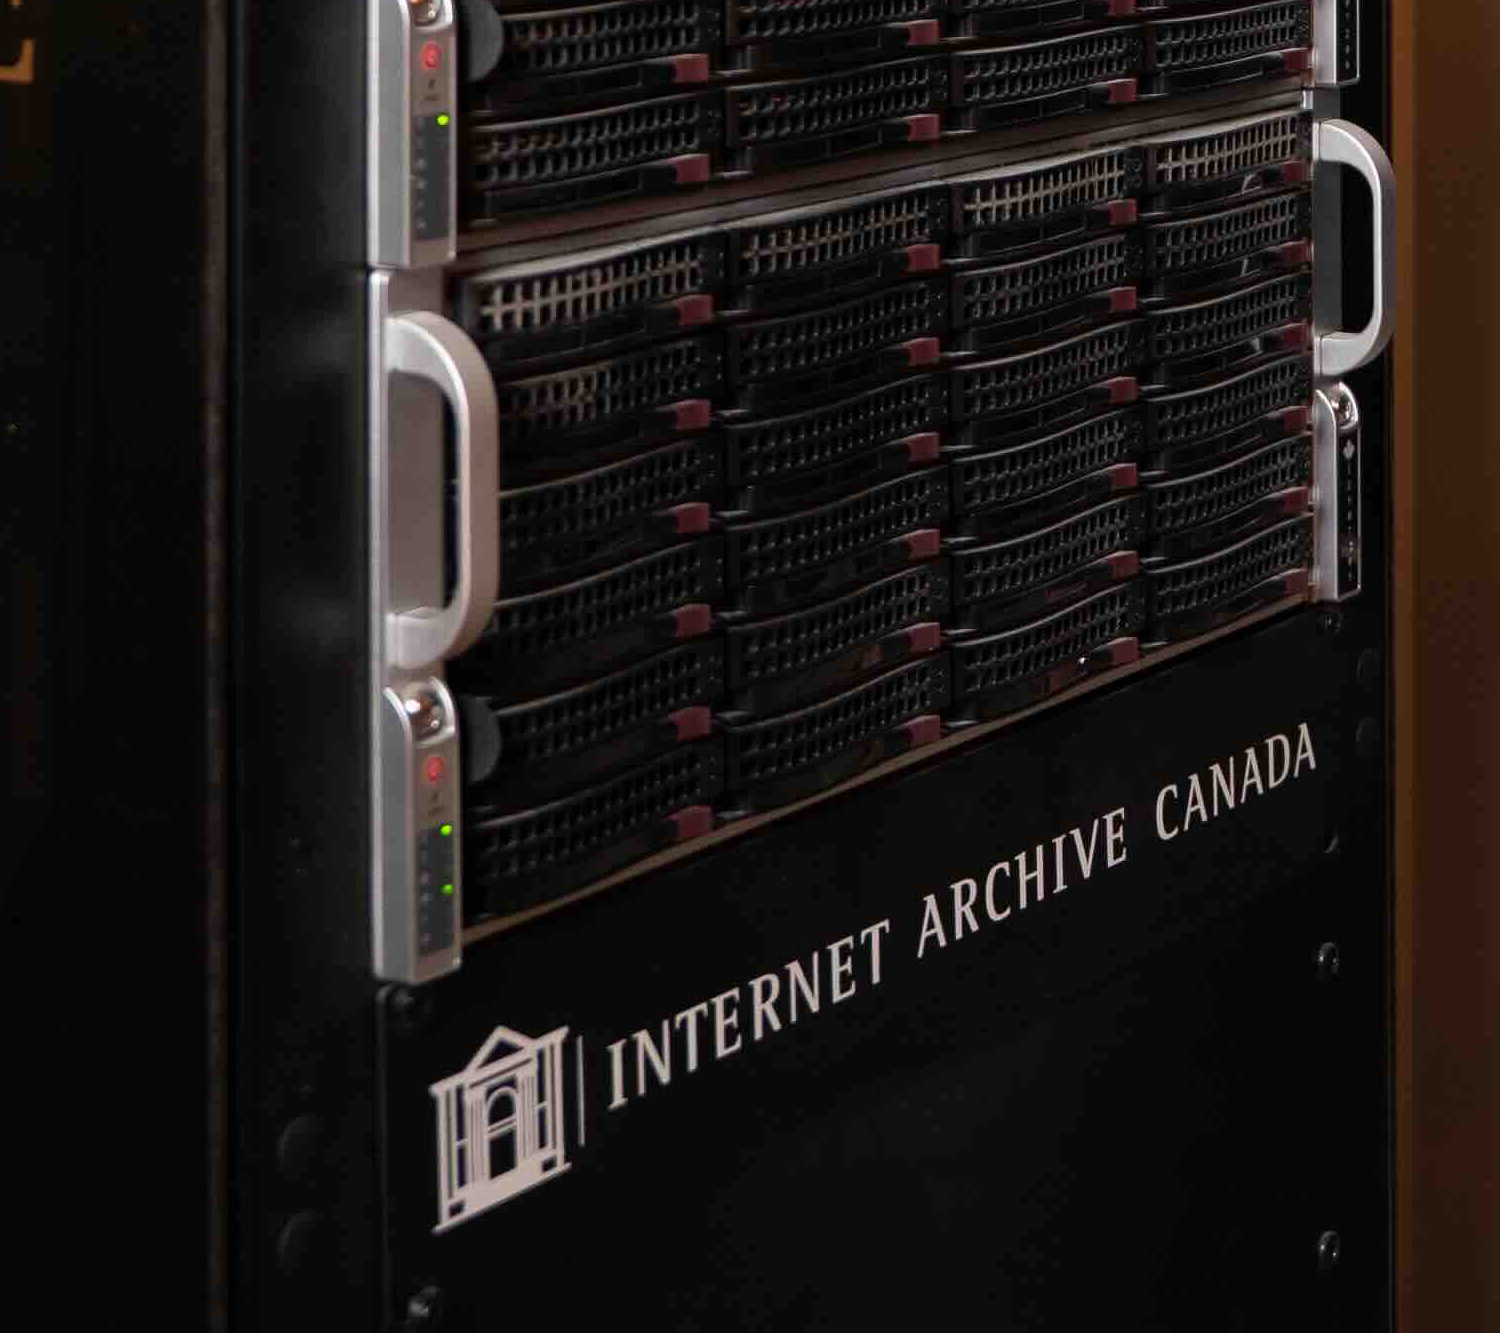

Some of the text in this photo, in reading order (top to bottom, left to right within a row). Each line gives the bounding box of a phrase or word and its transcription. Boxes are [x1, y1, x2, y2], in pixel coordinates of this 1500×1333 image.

[607, 721, 1317, 1110] INTERNET ARCHIVE CANADA
